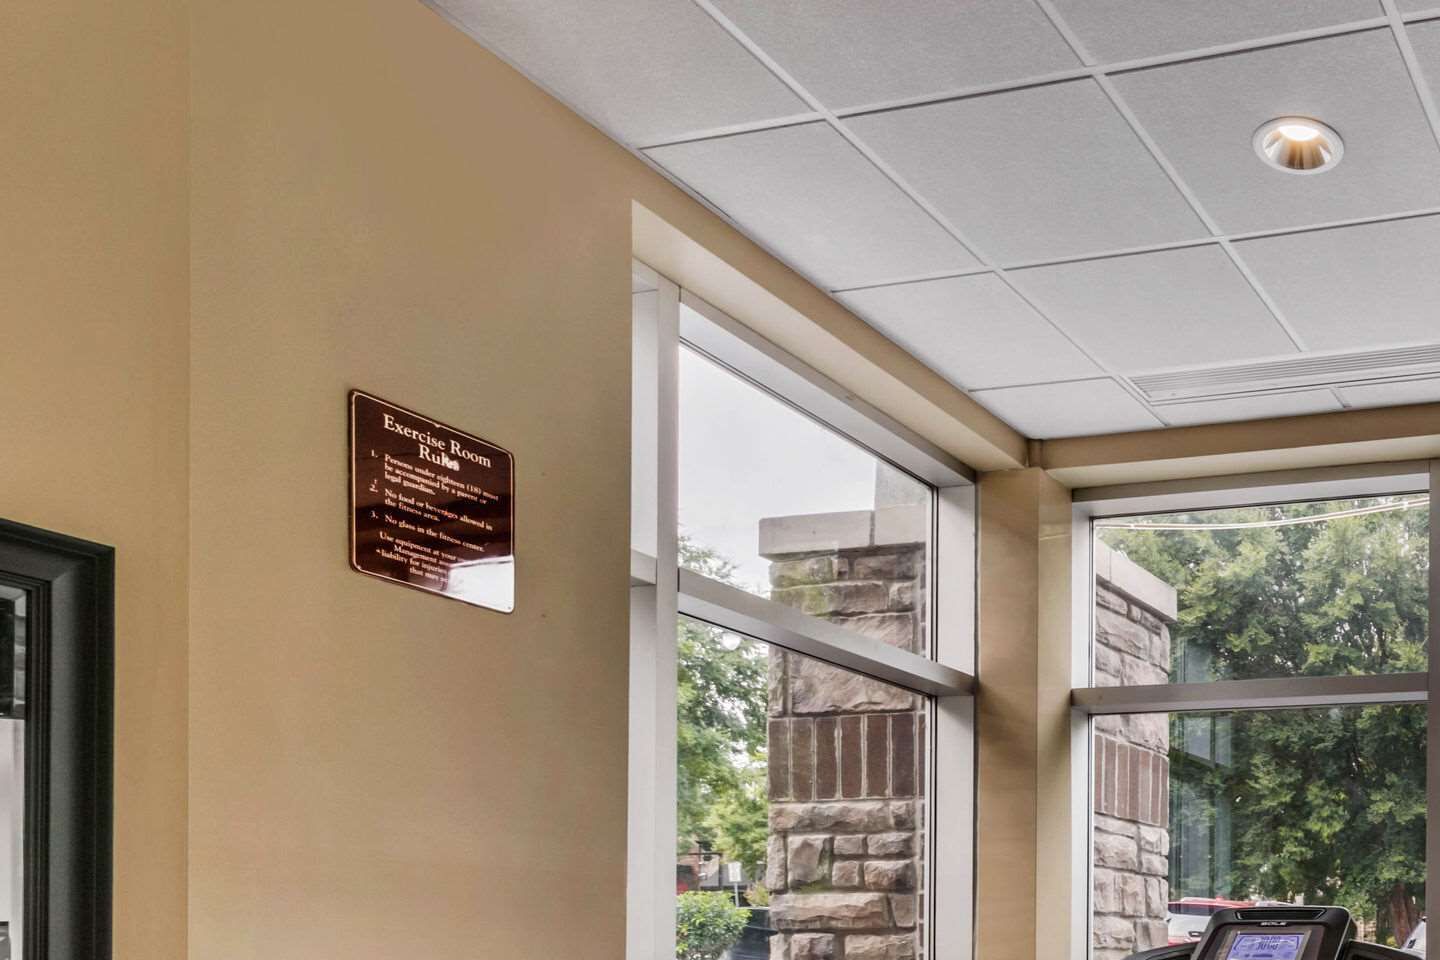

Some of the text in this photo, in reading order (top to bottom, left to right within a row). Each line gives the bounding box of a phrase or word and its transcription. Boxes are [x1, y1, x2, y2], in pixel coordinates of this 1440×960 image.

[383, 412, 492, 469] Exercise Room
[371, 449, 379, 458] 1.
[384, 453, 414, 471] Persons
[414, 466, 436, 479] under
[384, 461, 394, 472] be
[369, 484, 379, 494] 2.
[384, 487, 398, 500] No
[398, 492, 415, 505] food
[460, 514, 485, 529] allowed
[485, 522, 493, 532] in
[384, 497, 397, 508] the
[398, 502, 422, 515] fitness
[370, 510, 379, 520] 3.
[384, 514, 398, 525] No
[398, 520, 416, 531] glass
[417, 525, 425, 534] in
[426, 528, 438, 537] the
[439, 531, 462, 545] fitness
[379, 530, 395, 543] Use
[394, 538, 432, 554] equipment
[432, 548, 440, 556] at
[394, 544, 438, 563] Management
[409, 558, 420, 567] for
[409, 567, 424, 577] that
